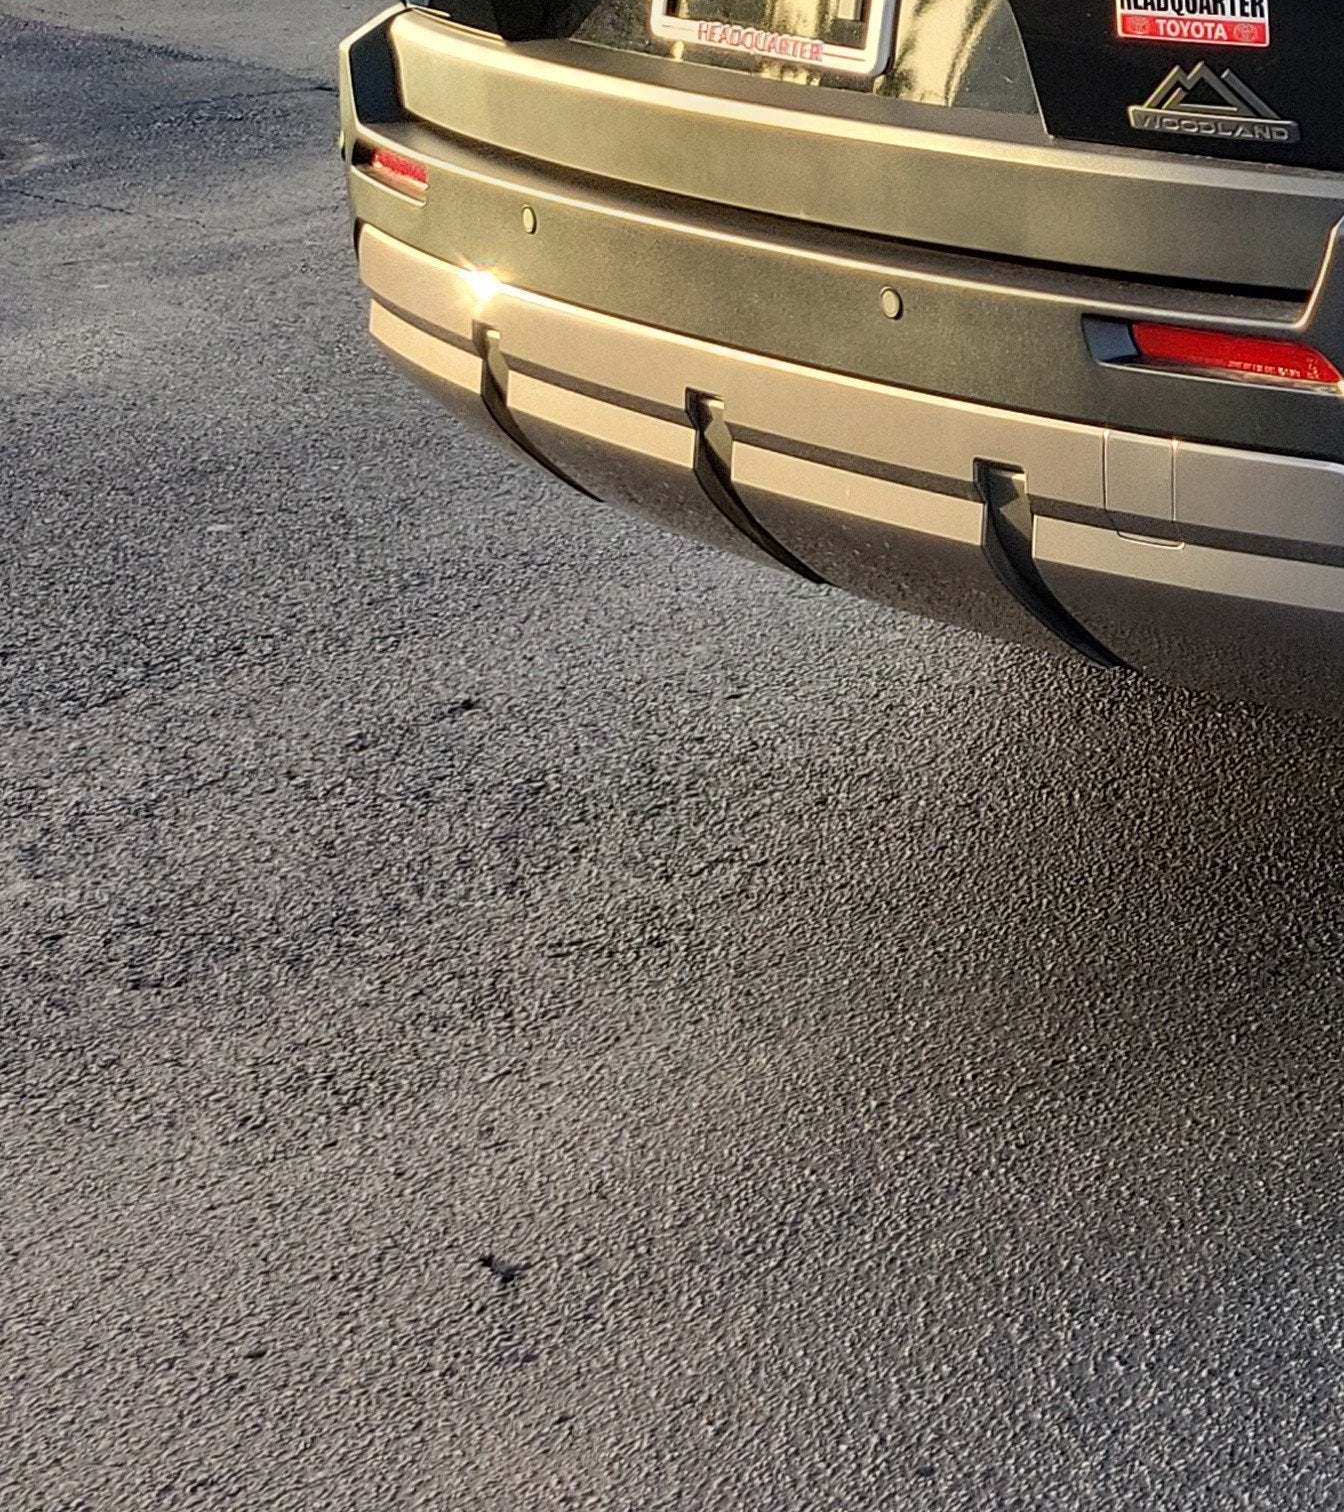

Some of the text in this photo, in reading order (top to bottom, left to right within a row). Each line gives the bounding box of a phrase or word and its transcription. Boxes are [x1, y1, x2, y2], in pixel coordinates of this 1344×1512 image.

[697, 20, 824, 62] HEADQUARTER
[1155, 18, 1229, 41] TOYOTA
[1136, 113, 1290, 141] WOODLAND
